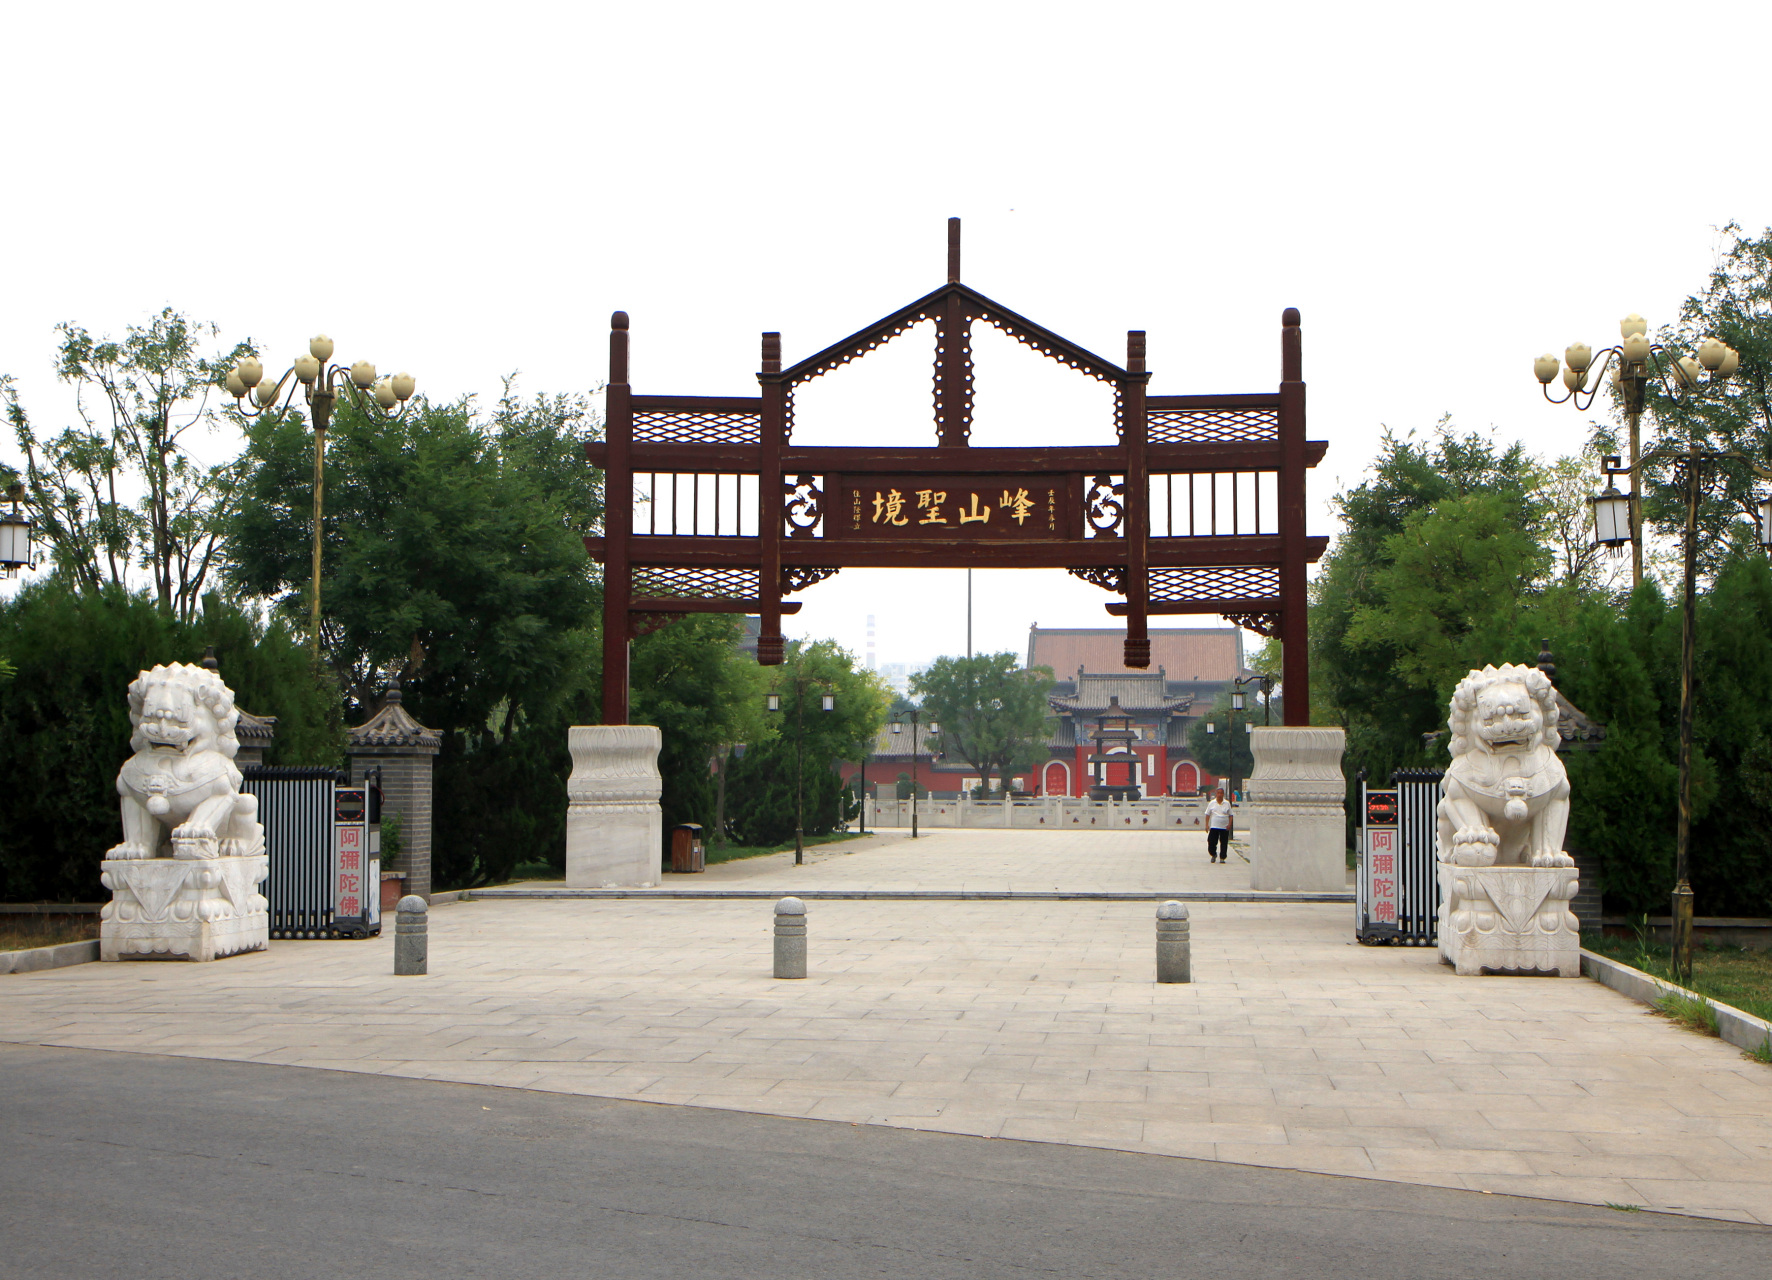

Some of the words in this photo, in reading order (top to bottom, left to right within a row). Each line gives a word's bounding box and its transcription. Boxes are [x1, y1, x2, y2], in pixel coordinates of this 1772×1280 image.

[339, 828, 360, 916] 阿彌陀佛
[1372, 831, 1395, 922] 阿彌陀佛
